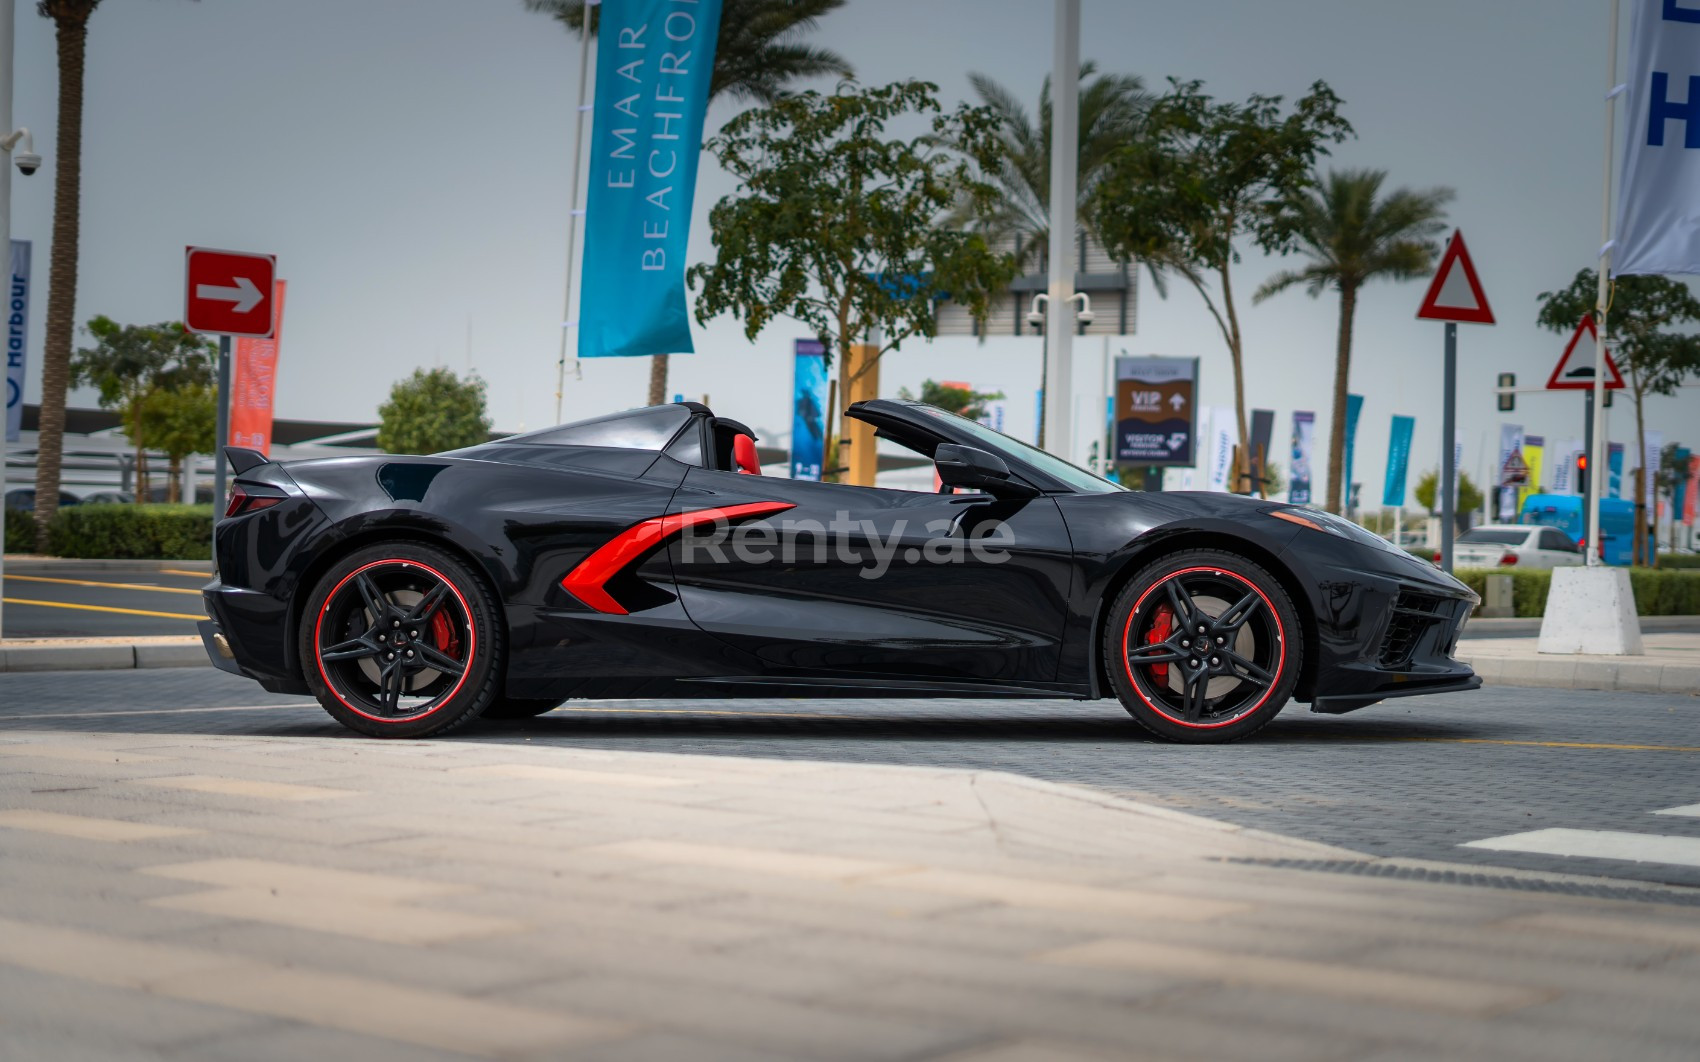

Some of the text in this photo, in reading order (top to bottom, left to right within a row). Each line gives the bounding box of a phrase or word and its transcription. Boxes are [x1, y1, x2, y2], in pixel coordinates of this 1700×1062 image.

[608, 24, 648, 188] EMAAR
[642, 0, 699, 271] BEACHFRO
[8, 273, 26, 368] Harbour
[1131, 391, 1162, 405] VIP
